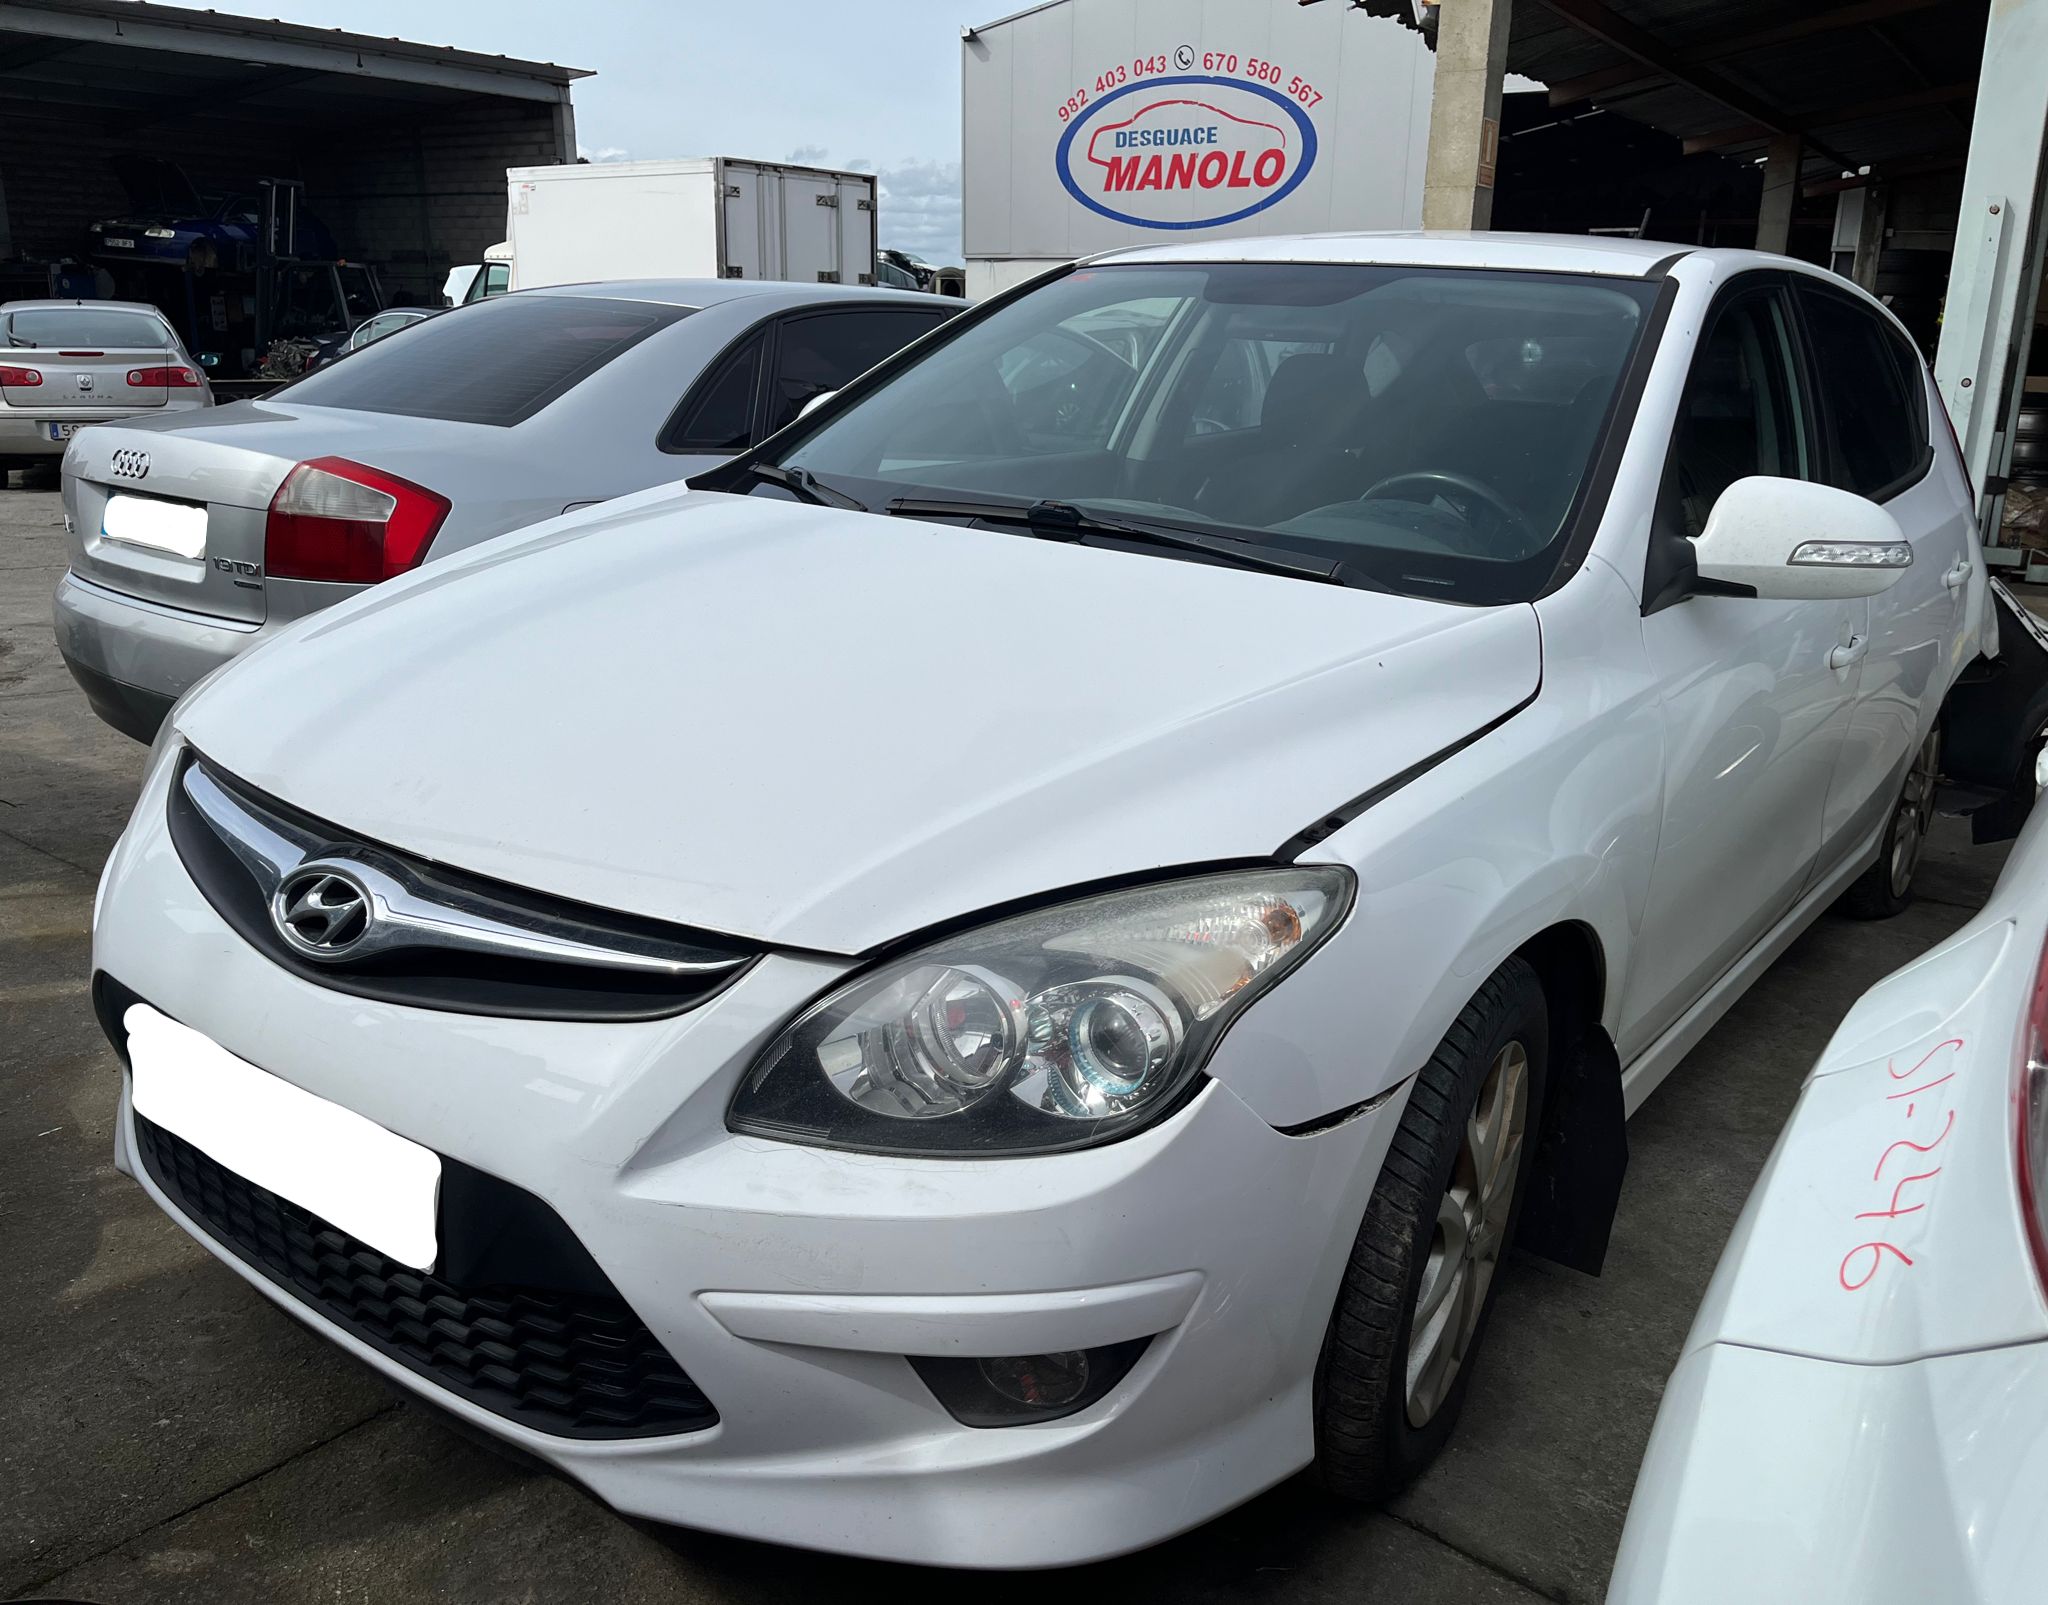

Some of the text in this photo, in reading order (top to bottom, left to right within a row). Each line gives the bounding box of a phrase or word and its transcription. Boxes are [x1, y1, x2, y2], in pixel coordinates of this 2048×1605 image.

[1058, 52, 1323, 122] 982 403 043 670 580 567
[1115, 126, 1218, 148] DESGUACE
[1103, 148, 1286, 192] MANOLO
